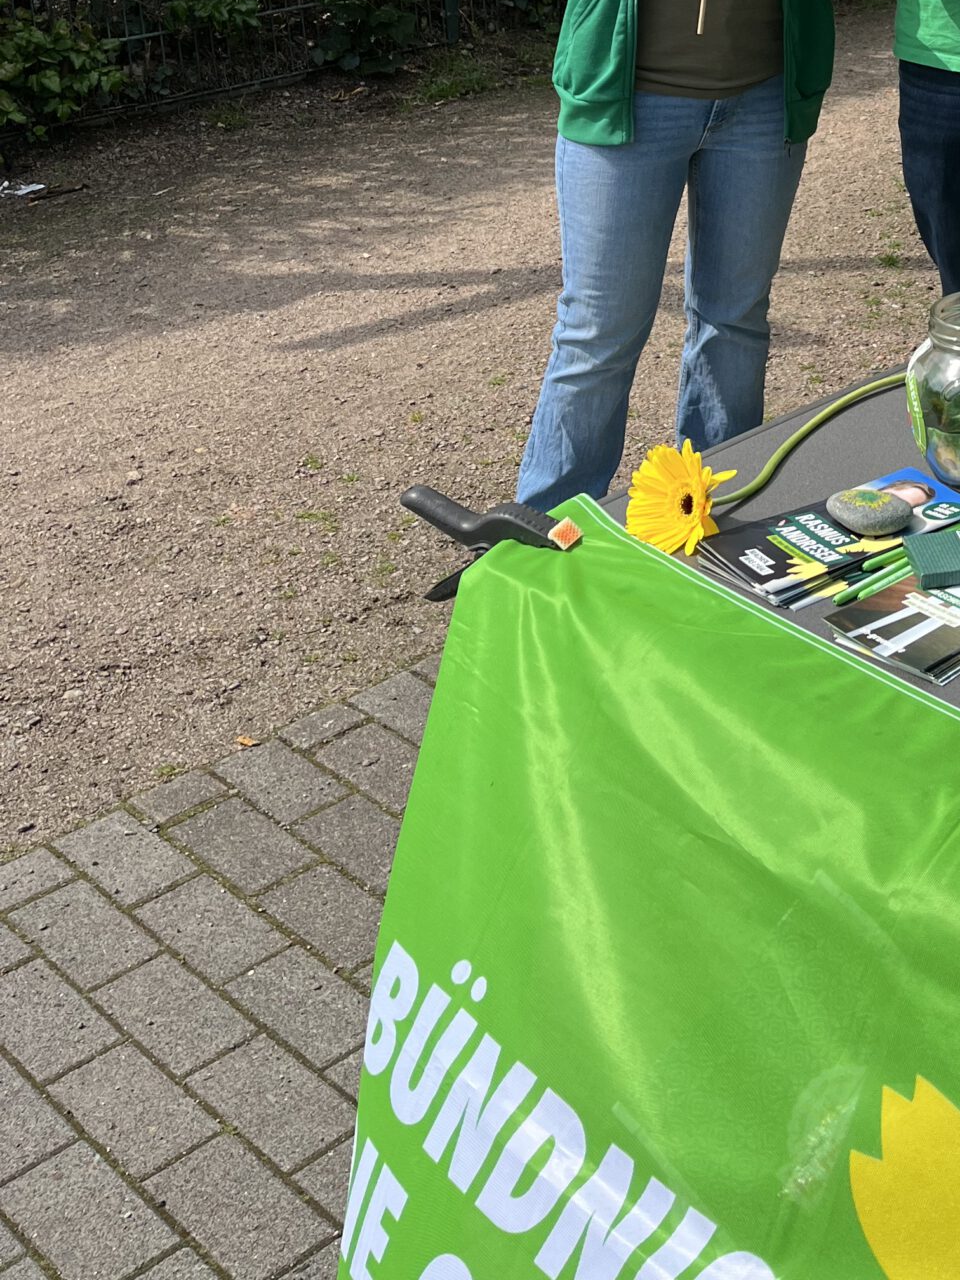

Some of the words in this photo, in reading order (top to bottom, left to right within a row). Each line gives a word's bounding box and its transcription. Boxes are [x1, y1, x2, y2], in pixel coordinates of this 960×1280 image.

[775, 525, 844, 562] ANDRESEN
[795, 513, 851, 546] RASMUS
[363, 939, 776, 1280] BÜNDNI
[339, 1138, 408, 1280] IE
